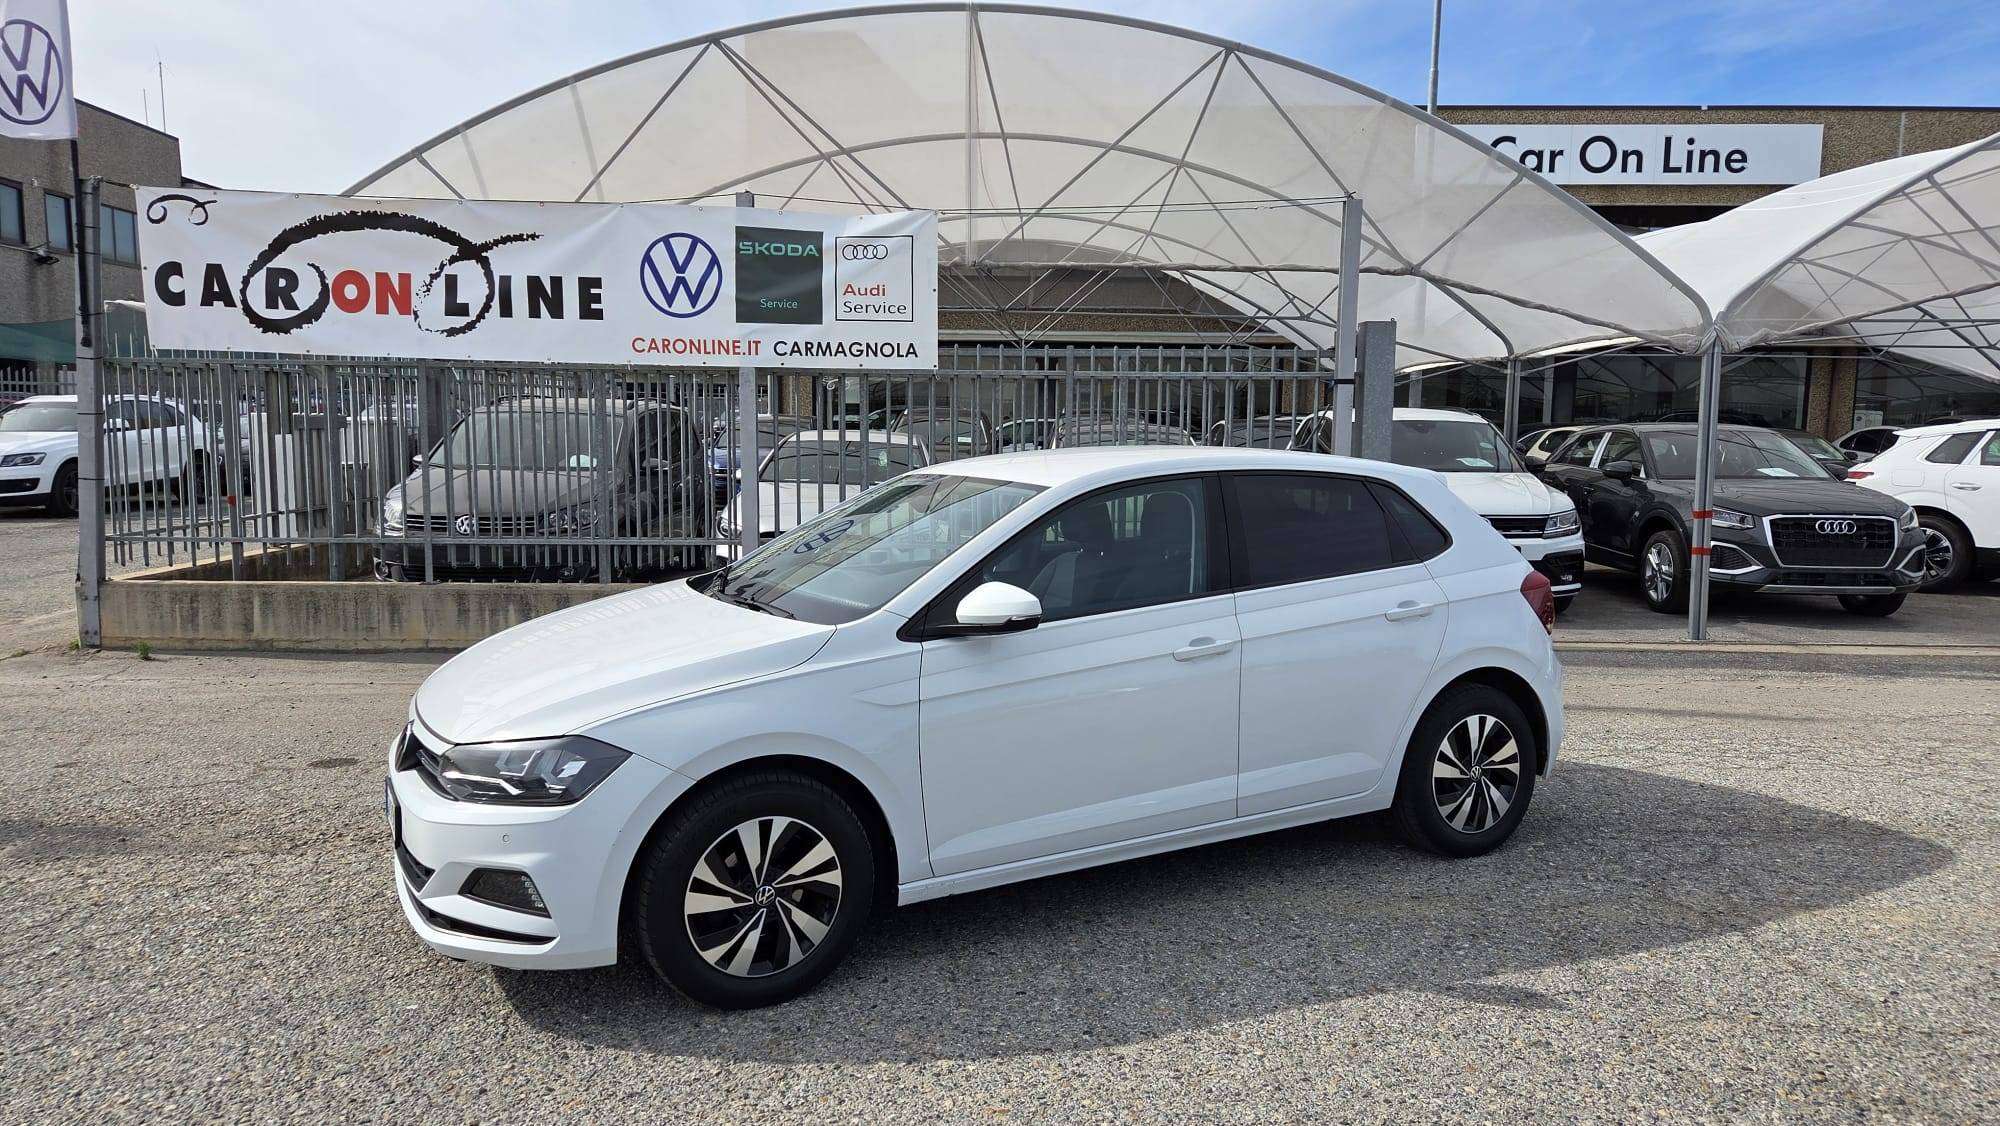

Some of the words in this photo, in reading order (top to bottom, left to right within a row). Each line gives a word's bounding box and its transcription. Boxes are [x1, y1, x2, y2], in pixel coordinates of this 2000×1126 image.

[1579, 135, 1644, 174] On
[1662, 135, 1748, 174] Line
[842, 283, 886, 297] Audi
[759, 298, 798, 309] Service
[842, 301, 907, 314] Service
[631, 337, 762, 356] CARONLINE.IT
[773, 340, 919, 358] CARMAGNOLA
